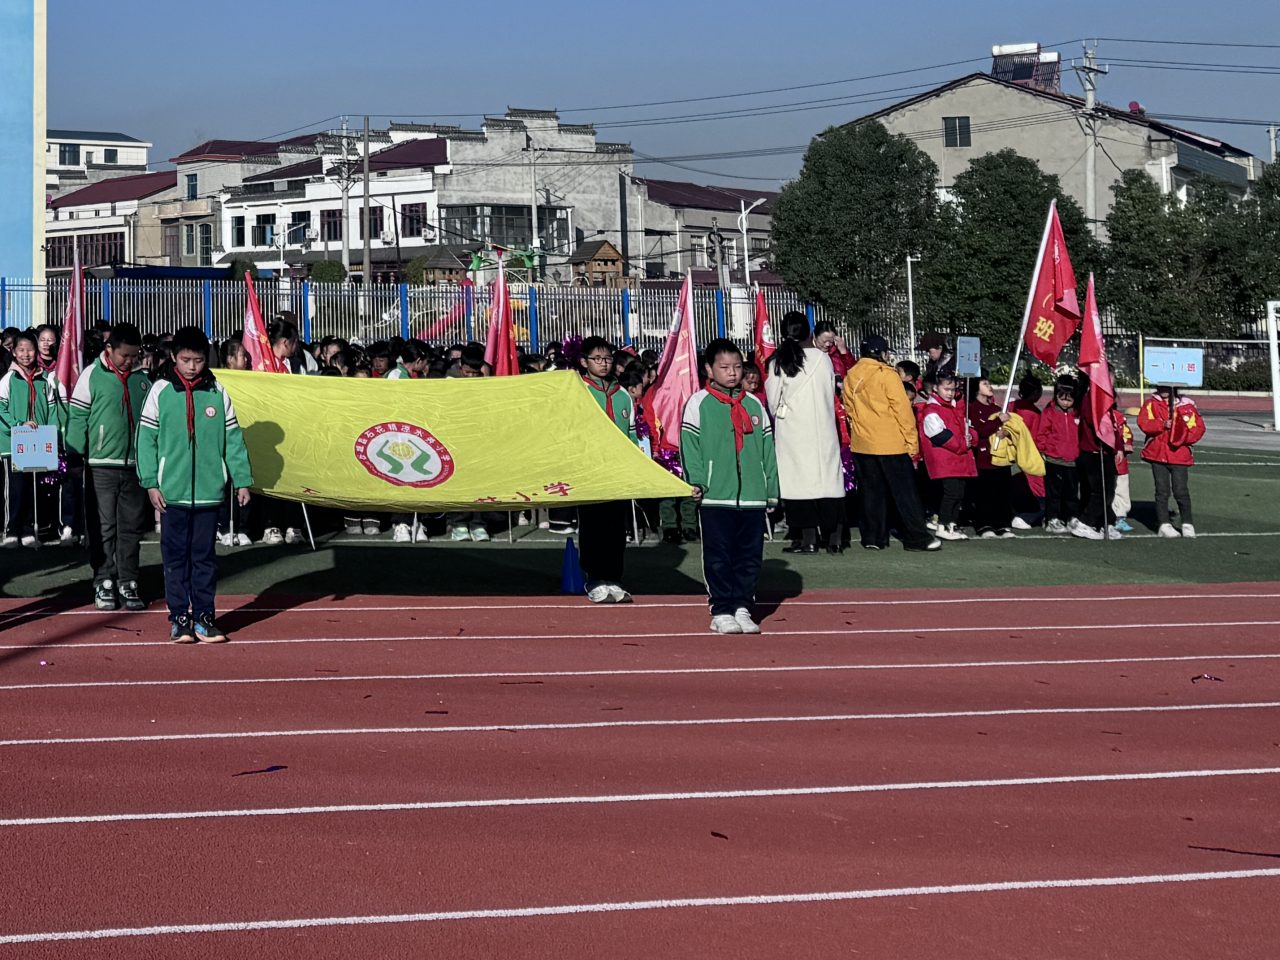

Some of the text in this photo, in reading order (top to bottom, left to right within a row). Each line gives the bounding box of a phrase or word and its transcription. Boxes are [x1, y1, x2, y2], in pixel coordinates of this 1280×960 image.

[1032, 316, 1055, 342] 班
[17, 443, 24, 454] 四
[45, 442, 53, 453] 班
